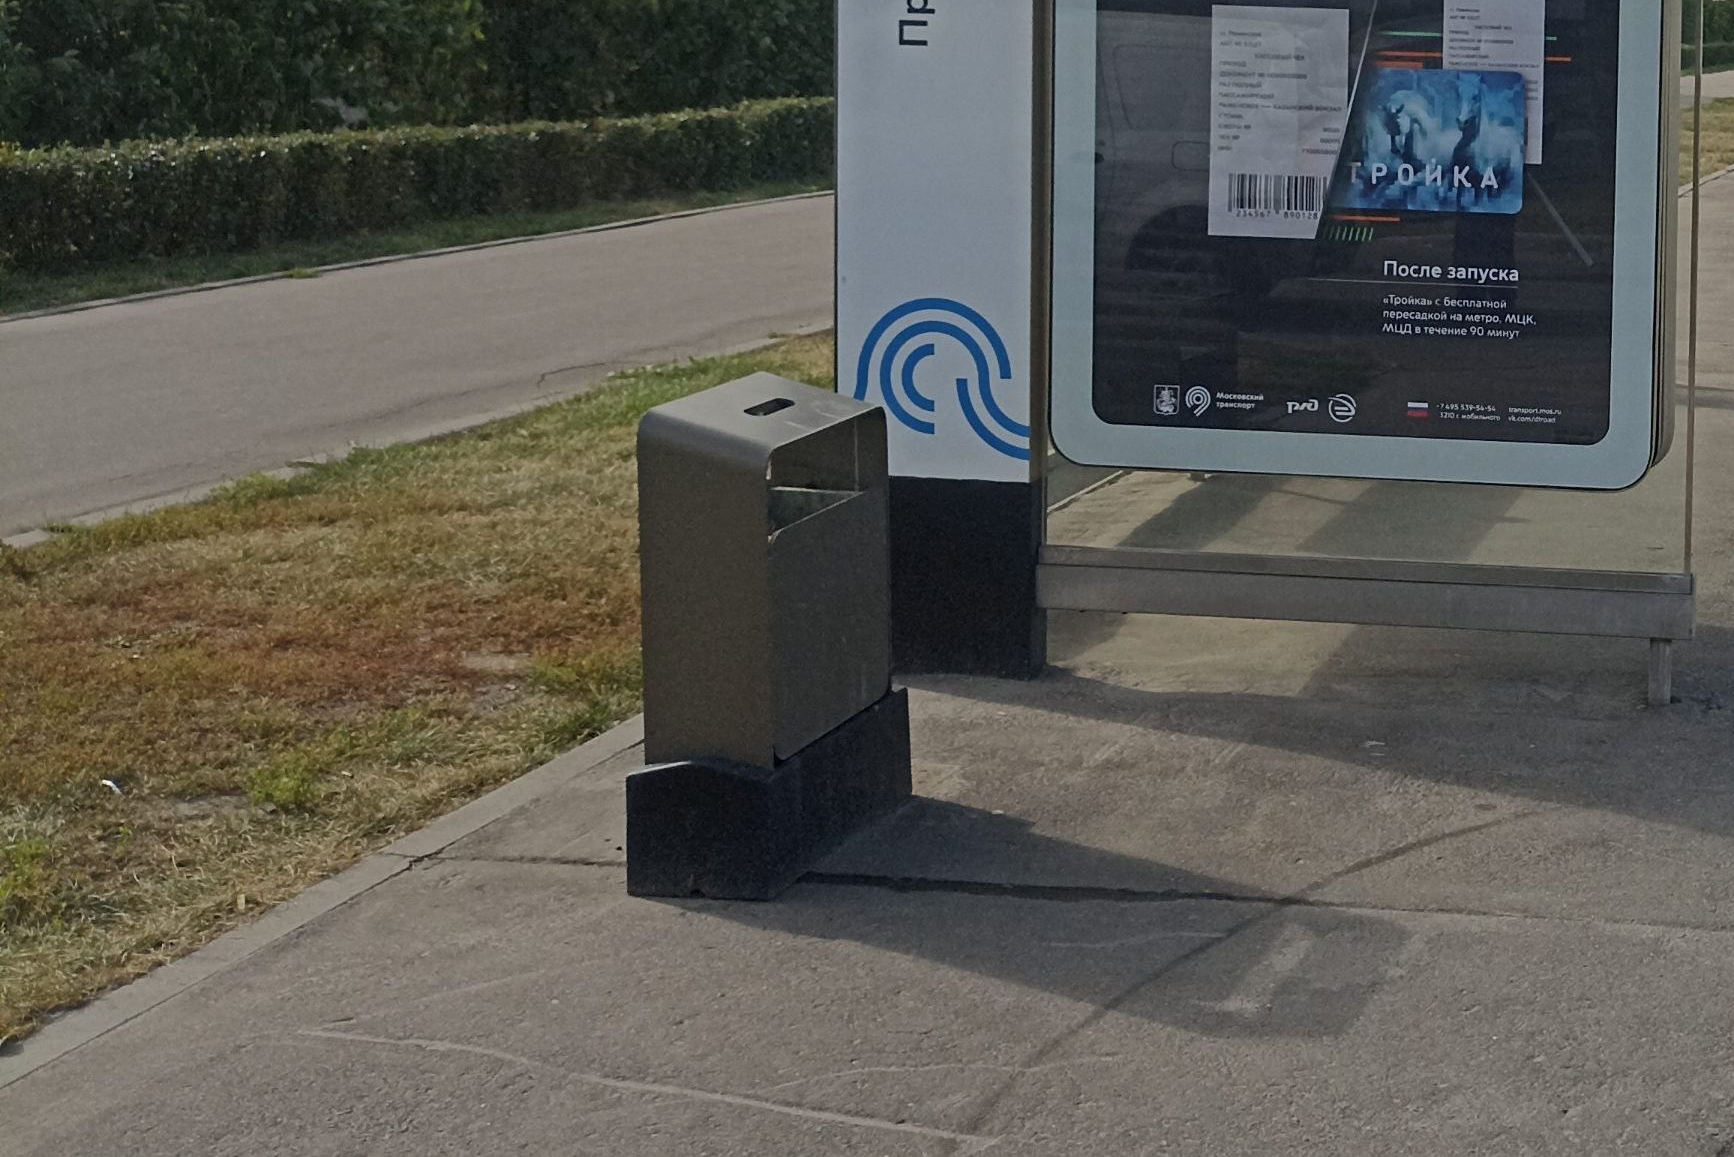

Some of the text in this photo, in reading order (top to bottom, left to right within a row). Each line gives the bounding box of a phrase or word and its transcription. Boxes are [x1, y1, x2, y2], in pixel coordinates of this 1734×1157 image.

[1348, 157, 1499, 190] ТРОЙКА
[1382, 259, 1520, 284] После запуска
[1382, 294, 1507, 309] «Тройка» с бесплатной
[1382, 309, 1448, 322] пересадкой
[1449, 314, 1463, 322] на
[1504, 313, 1537, 326] МЦК,
[1381, 323, 1521, 341] МЦД в течение 90 минут
[1215, 391, 1264, 401] Московский
[1215, 401, 1255, 411] транспорт
[1508, 406, 1562, 416] transport.mos.ru
